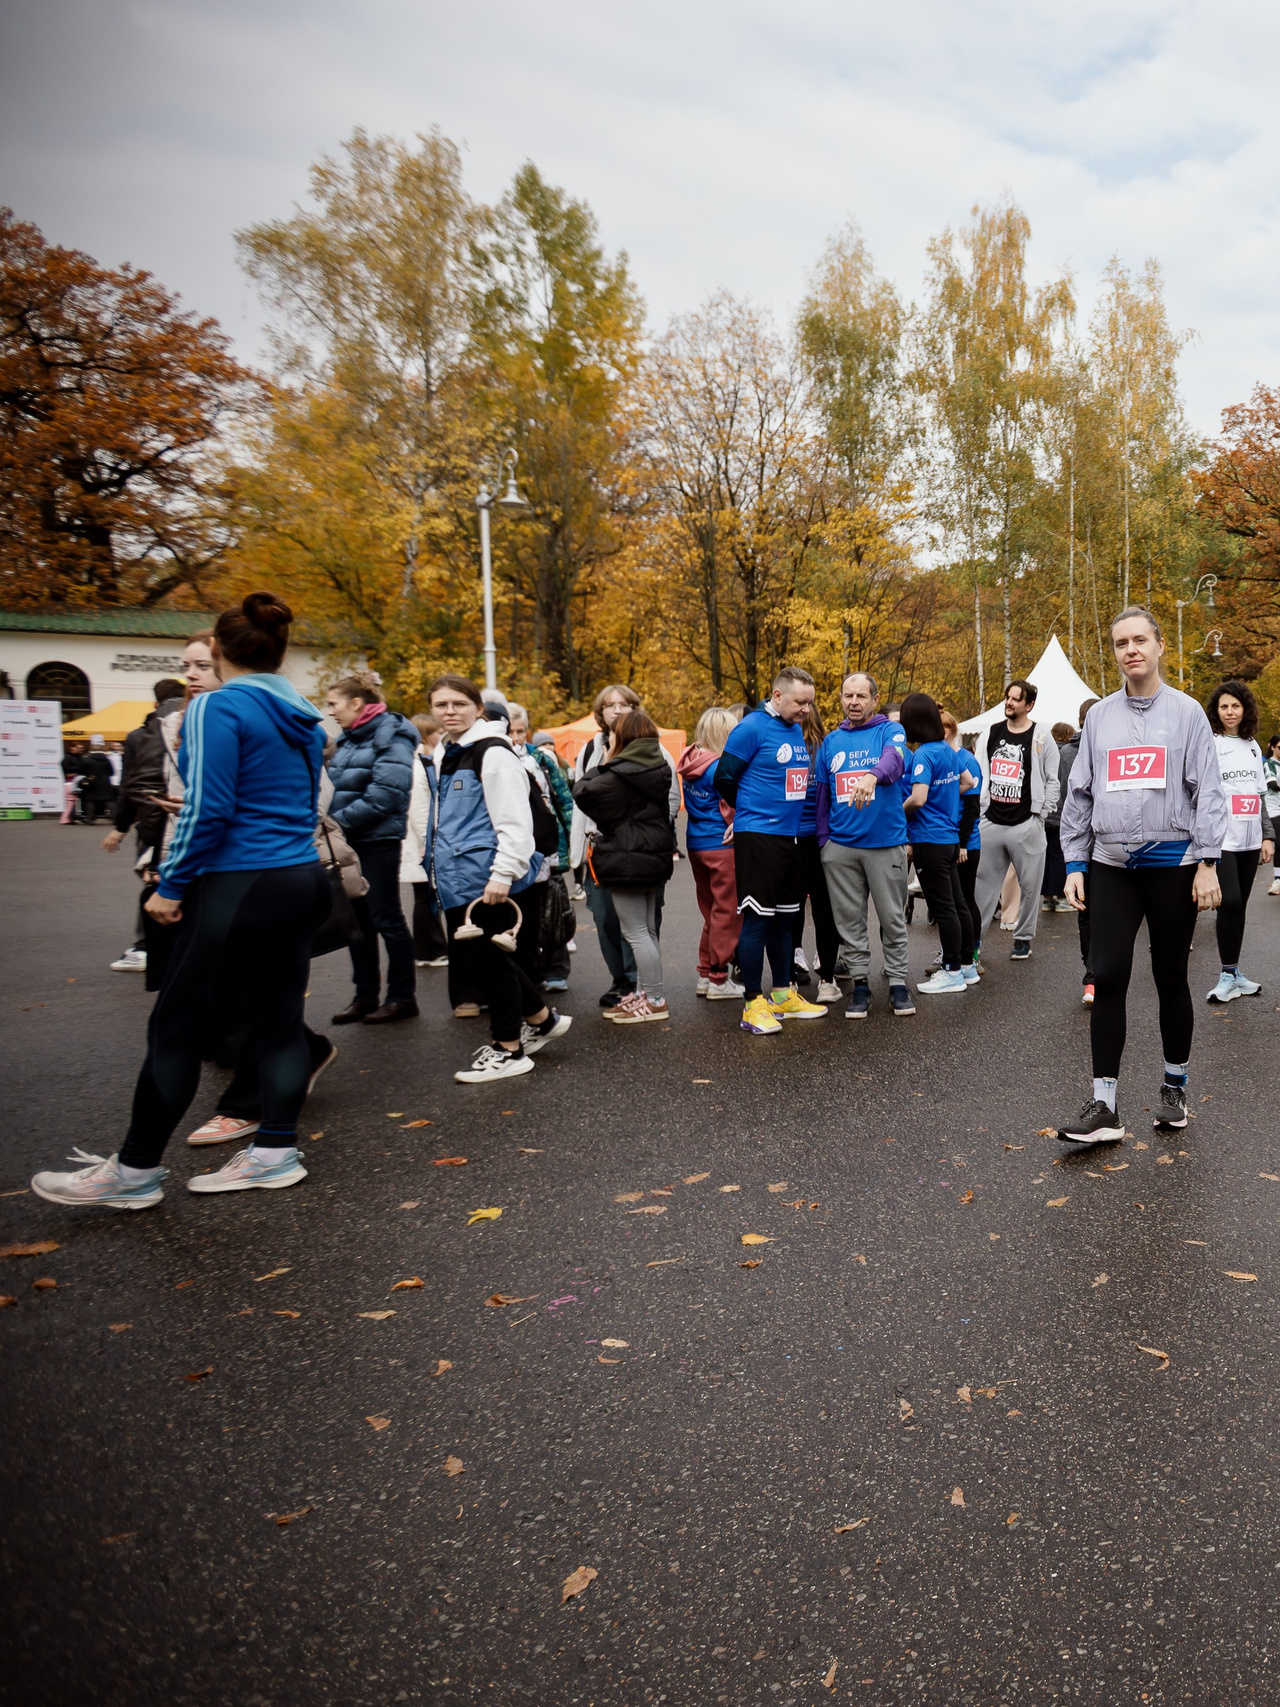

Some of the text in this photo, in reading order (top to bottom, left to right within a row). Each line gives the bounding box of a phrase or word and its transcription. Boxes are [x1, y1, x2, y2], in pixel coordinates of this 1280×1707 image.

[849, 749, 870, 759] БЕГУ
[848, 760, 859, 768] ЗА
[995, 762, 1017, 777] 187
[1117, 753, 1157, 776] 137
[1222, 770, 1258, 780] ВОЛОНТЕ
[841, 776, 864, 793] 19
[1240, 798, 1257, 812] 37
